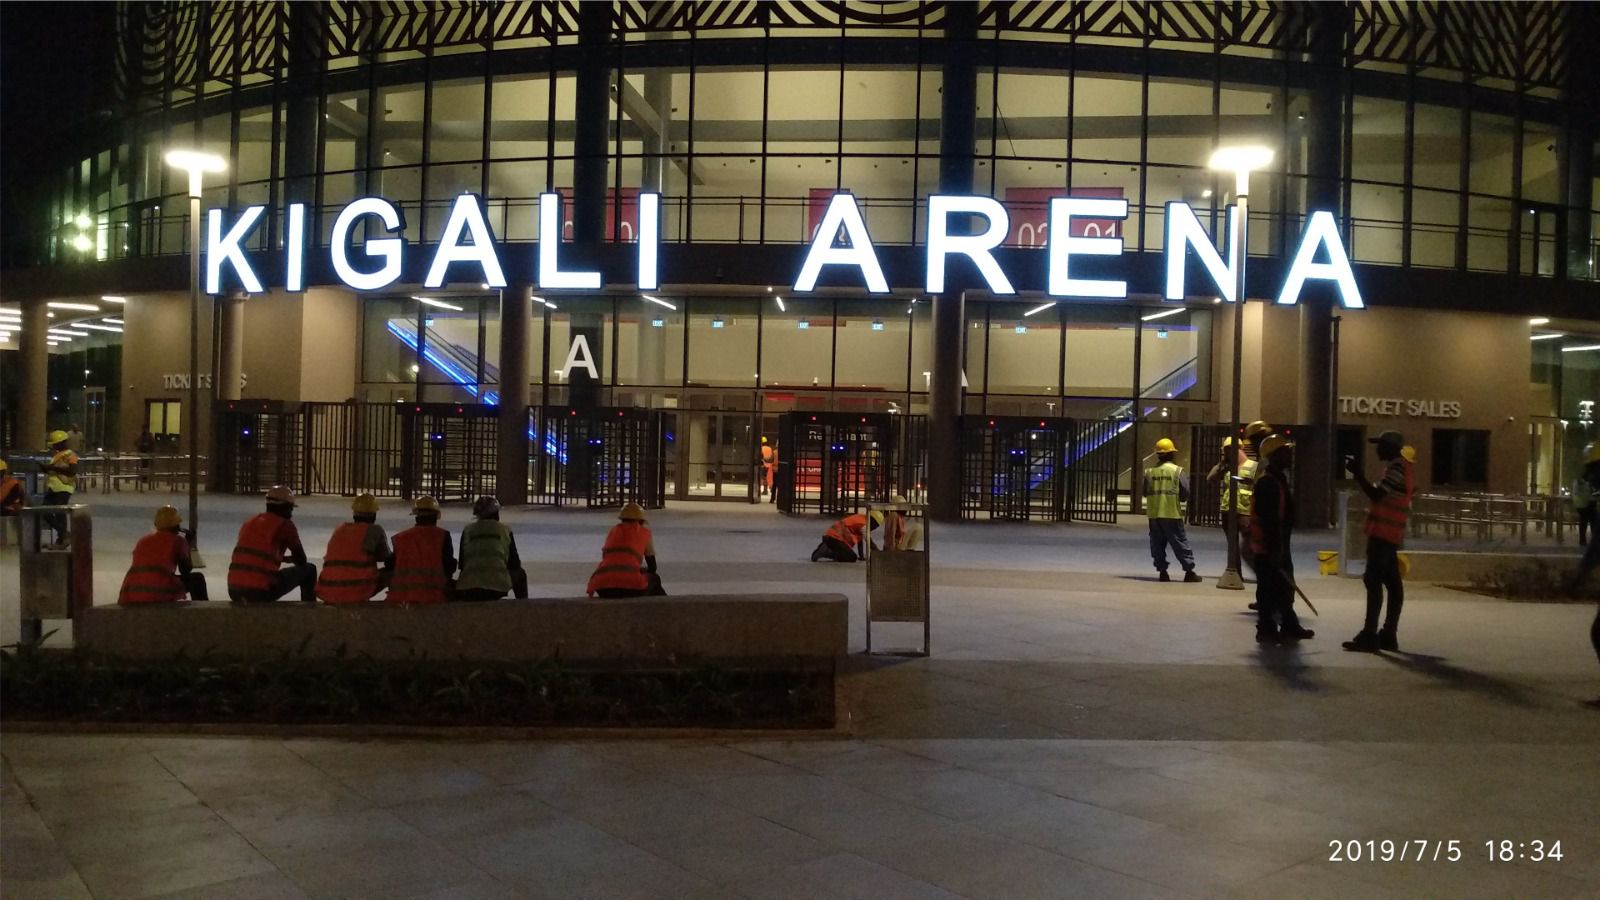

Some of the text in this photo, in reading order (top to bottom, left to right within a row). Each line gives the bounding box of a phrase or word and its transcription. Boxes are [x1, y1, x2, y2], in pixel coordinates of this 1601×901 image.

[206, 193, 1365, 308] KIGALI ARENA
[563, 335, 599, 379] A
[163, 374, 206, 389] TICKT
[1339, 396, 1461, 418] TICKET SALES
